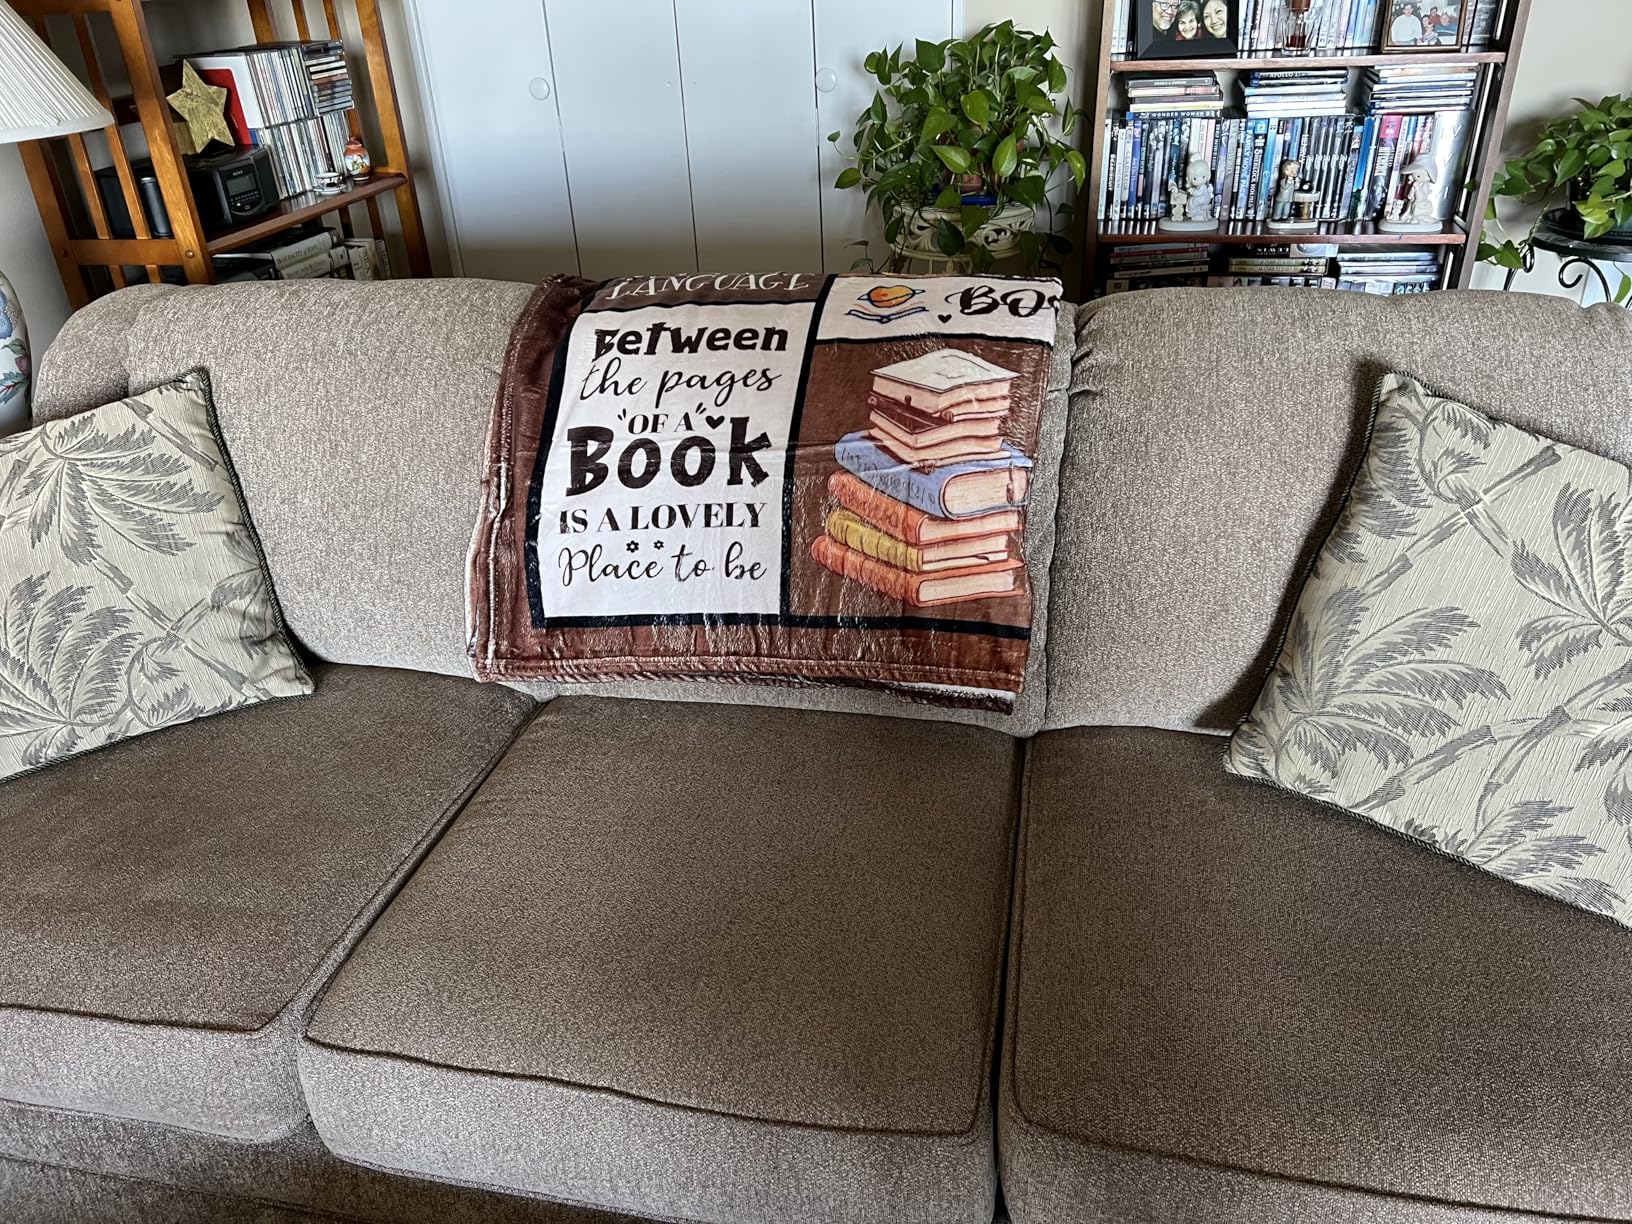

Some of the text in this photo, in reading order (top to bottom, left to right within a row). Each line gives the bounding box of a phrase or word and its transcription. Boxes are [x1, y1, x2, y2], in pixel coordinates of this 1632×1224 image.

[1243, 130, 1254, 158] FAMILY
[1374, 146, 1391, 177] HITCHCOCK
[1108, 153, 1117, 191] SEABISCUIT
[1248, 148, 1263, 207] SHERLOCK HOLMES
[606, 272, 814, 300] LANGUAGE
[592, 322, 788, 363] Between
[580, 356, 783, 408] the pages
[558, 501, 768, 535] IS A LOVELY
[558, 541, 768, 587] Place to be
